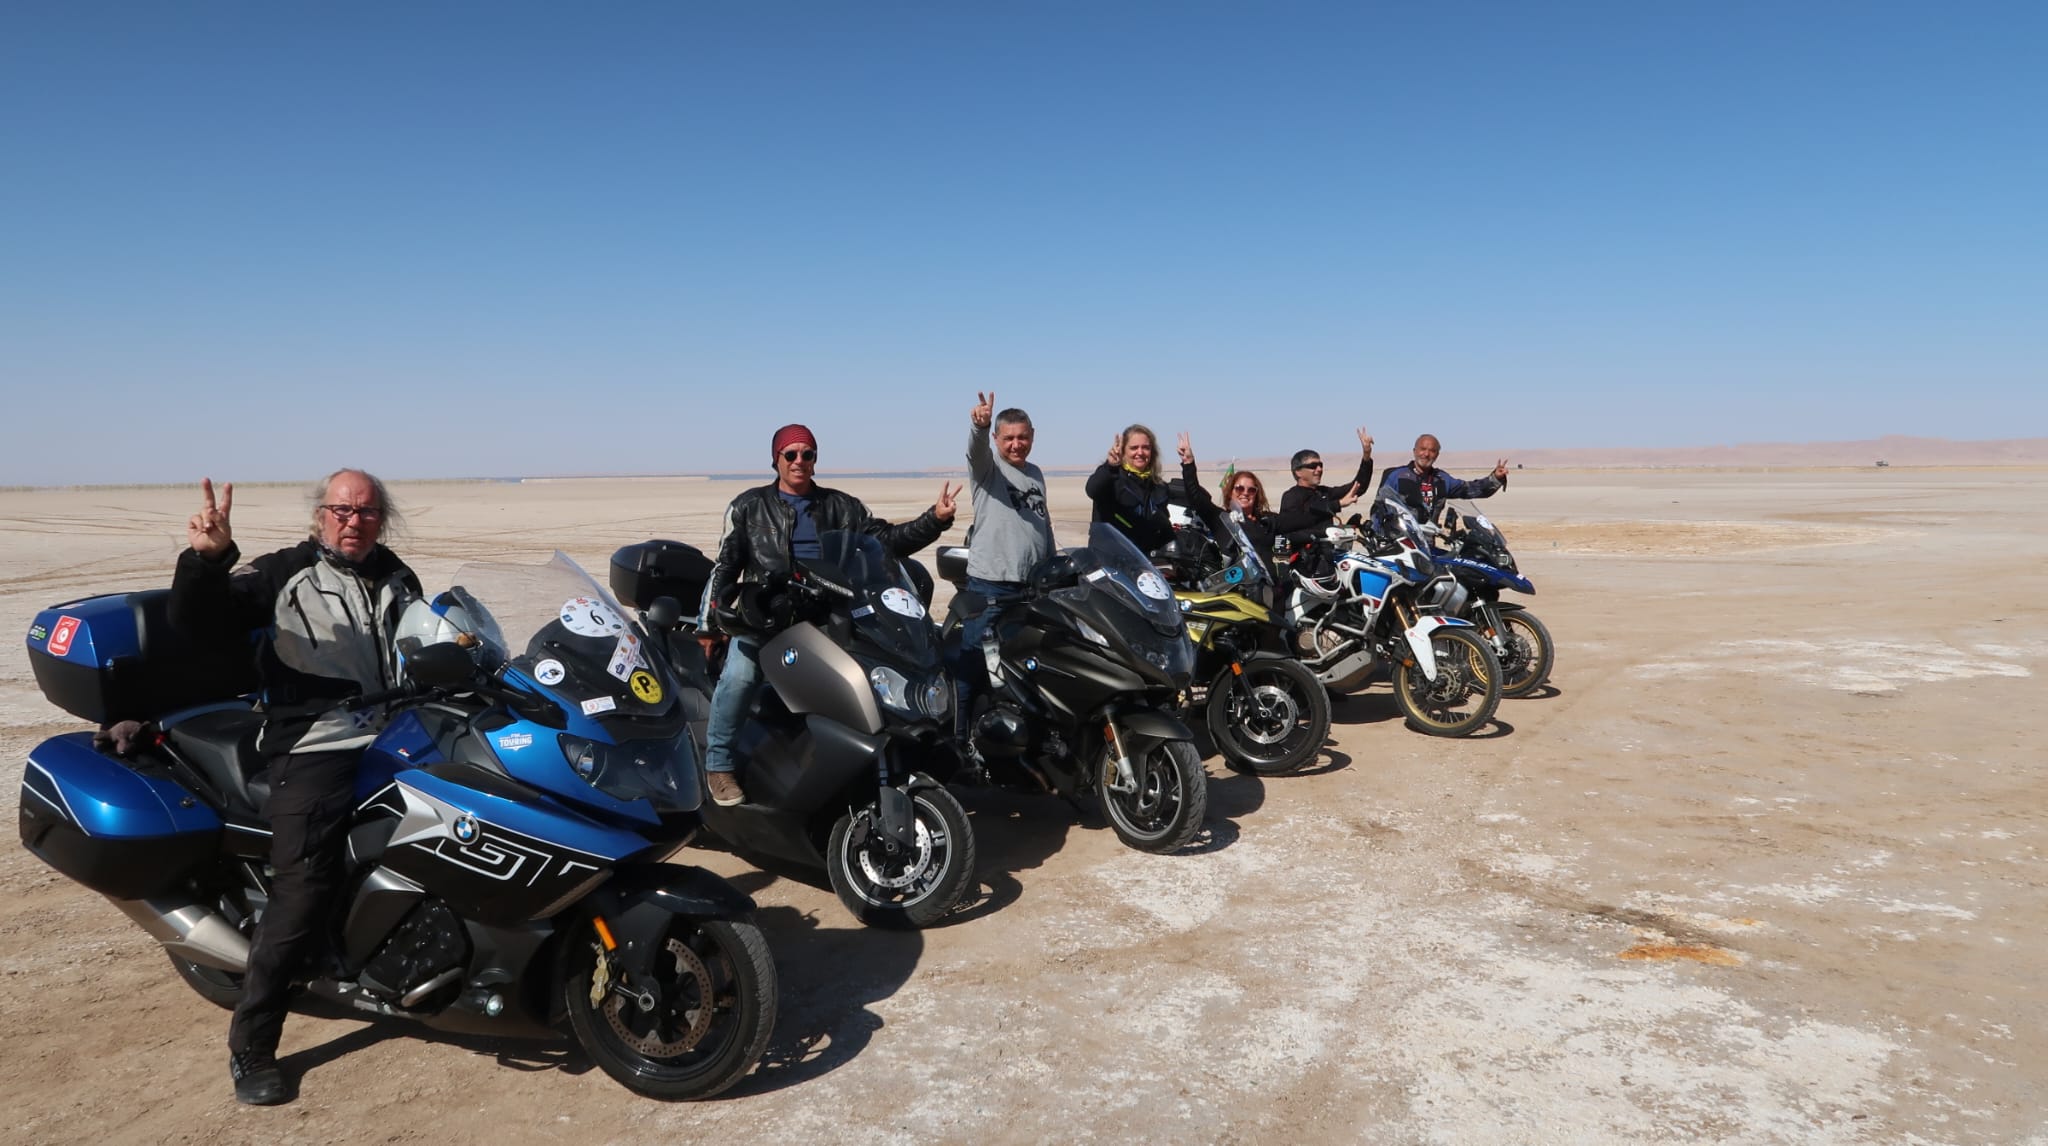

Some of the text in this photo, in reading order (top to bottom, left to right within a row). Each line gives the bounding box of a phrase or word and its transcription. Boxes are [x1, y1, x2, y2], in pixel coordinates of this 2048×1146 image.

[1229, 569, 1237, 579] P
[901, 598, 909, 609] 7
[590, 609, 605, 625] 6
[636, 675, 650, 694] P
[499, 735, 533, 748] TOURING
